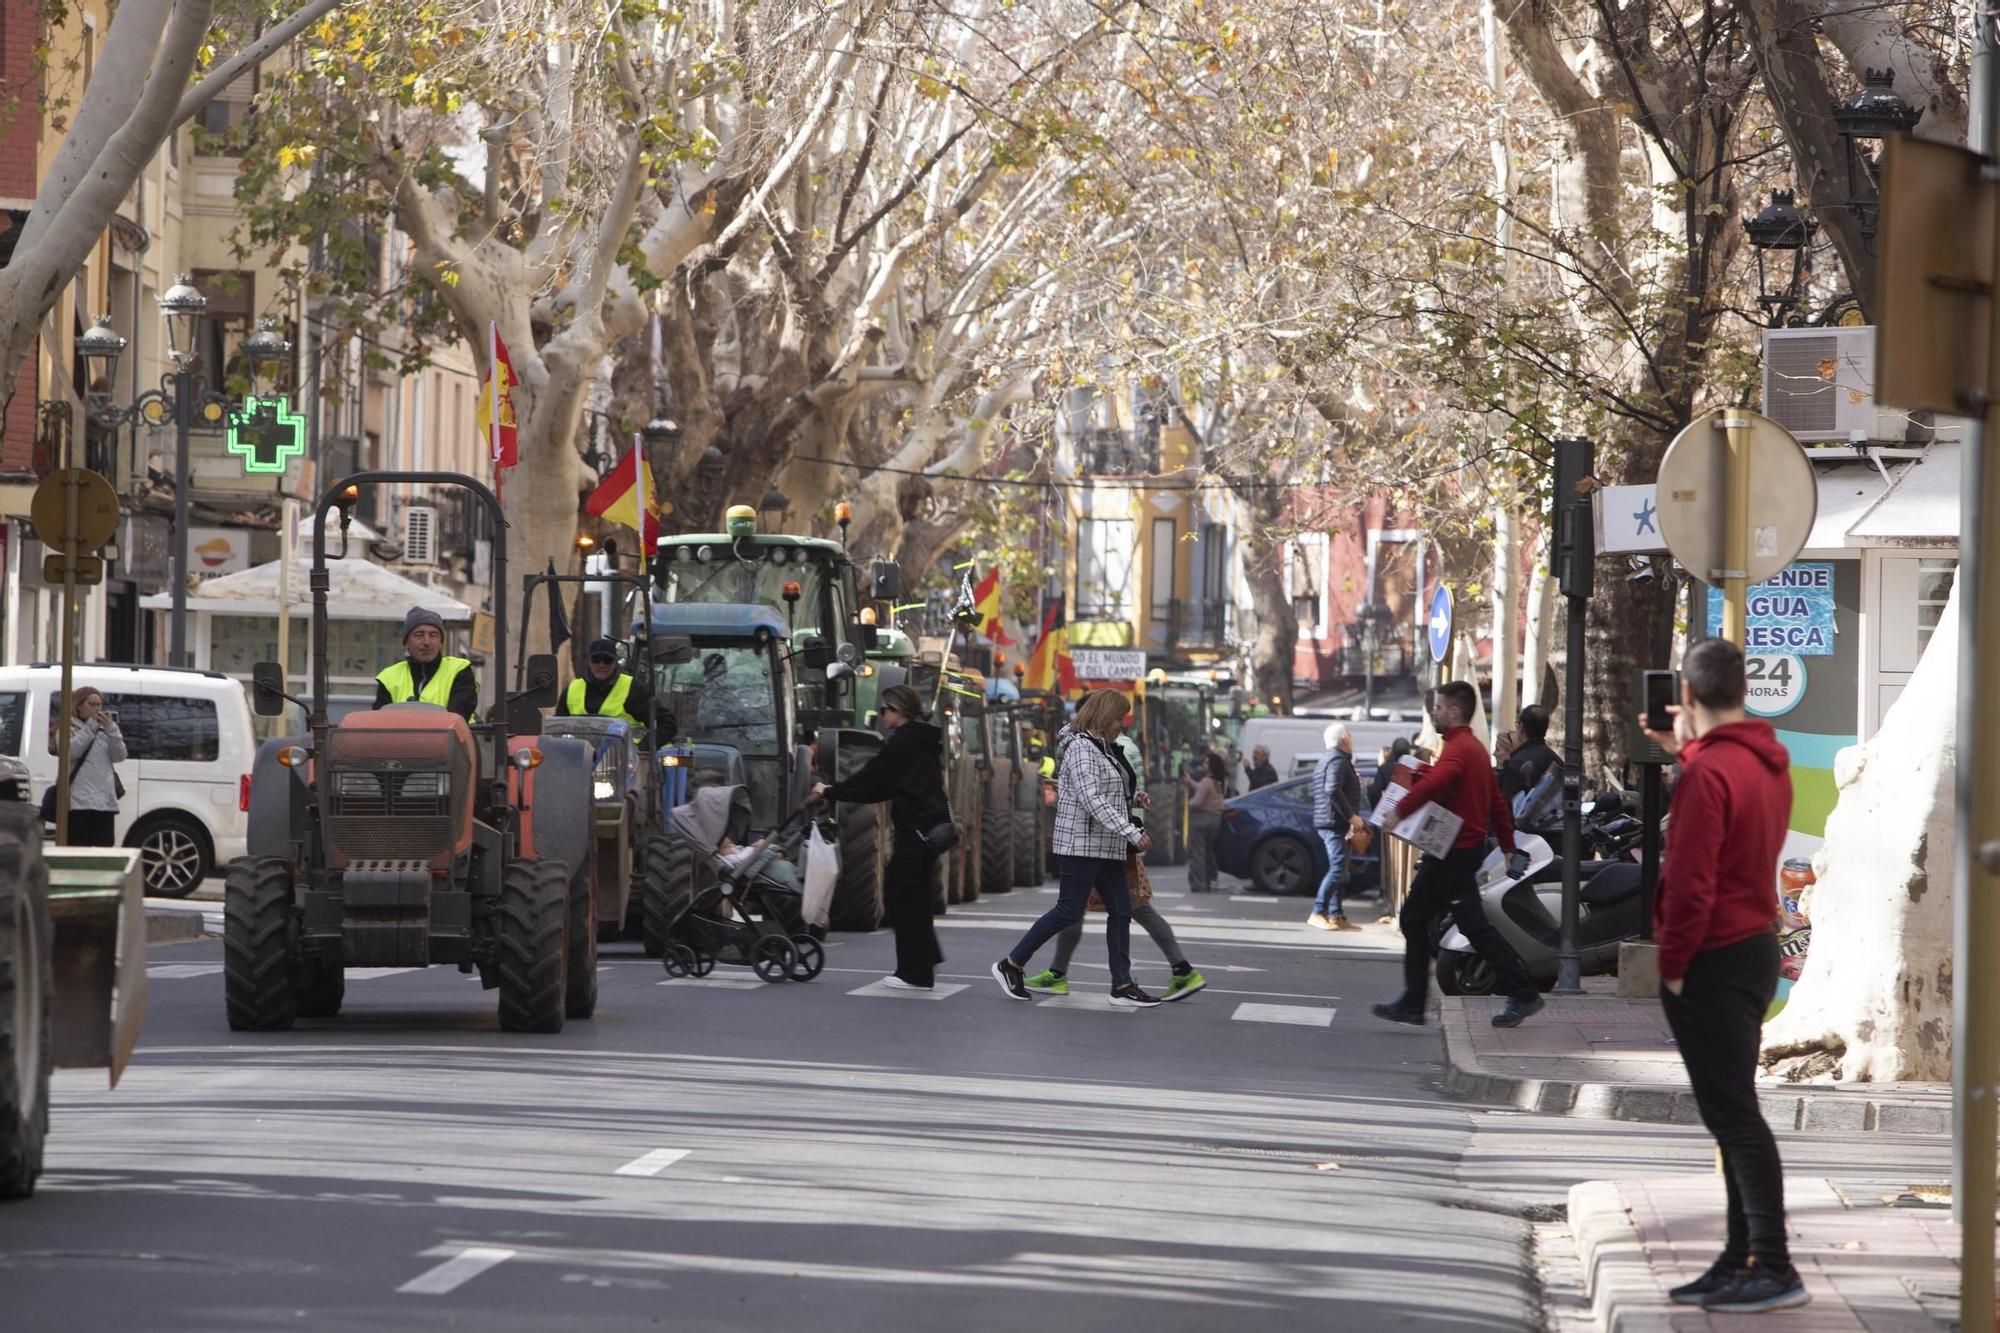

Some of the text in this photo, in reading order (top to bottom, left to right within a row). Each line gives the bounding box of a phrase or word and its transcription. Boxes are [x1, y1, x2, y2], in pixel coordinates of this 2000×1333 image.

[1757, 571, 1827, 586] ENDE
[1104, 653, 1140, 665] MUNDO
[1108, 665, 1142, 677] CAMPO
[1746, 658, 1792, 687] 24
